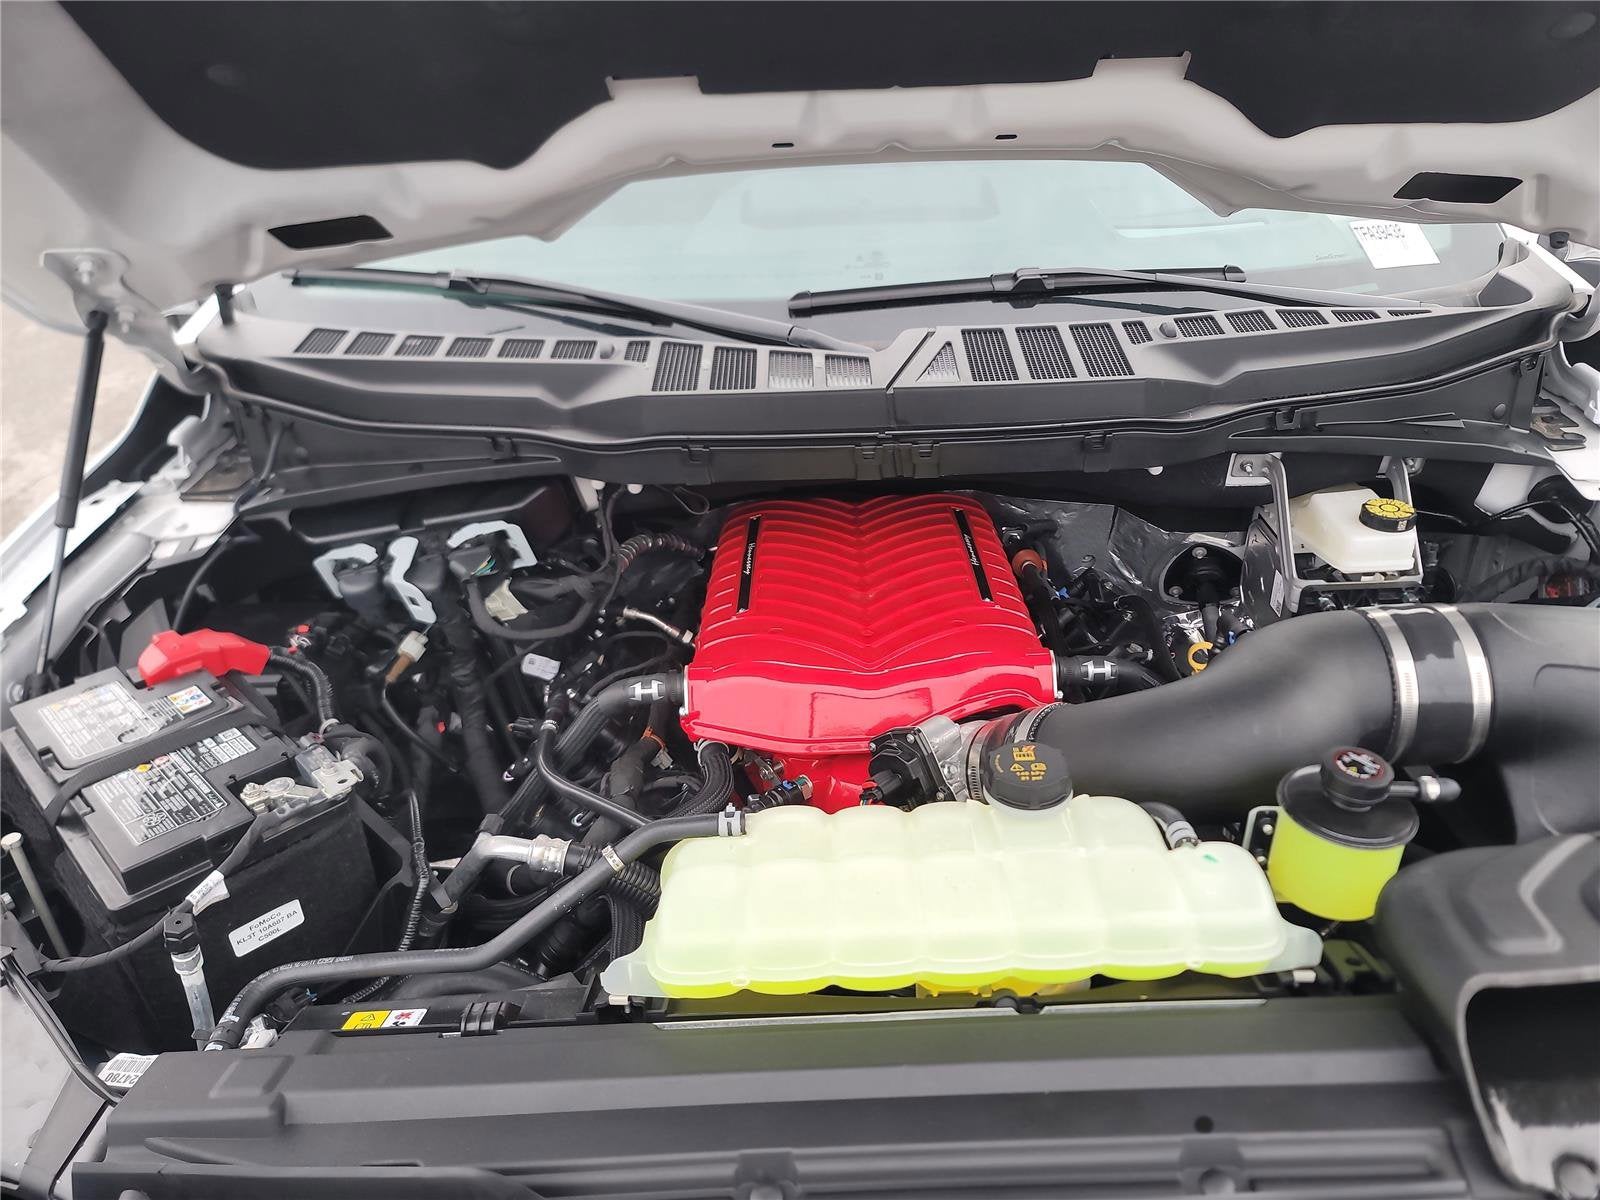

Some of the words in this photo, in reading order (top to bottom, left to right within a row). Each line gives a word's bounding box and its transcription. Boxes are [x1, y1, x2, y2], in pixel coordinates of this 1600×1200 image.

[1081, 660, 1117, 681] H
[629, 679, 665, 702] H
[248, 911, 281, 931] FoMoCo
